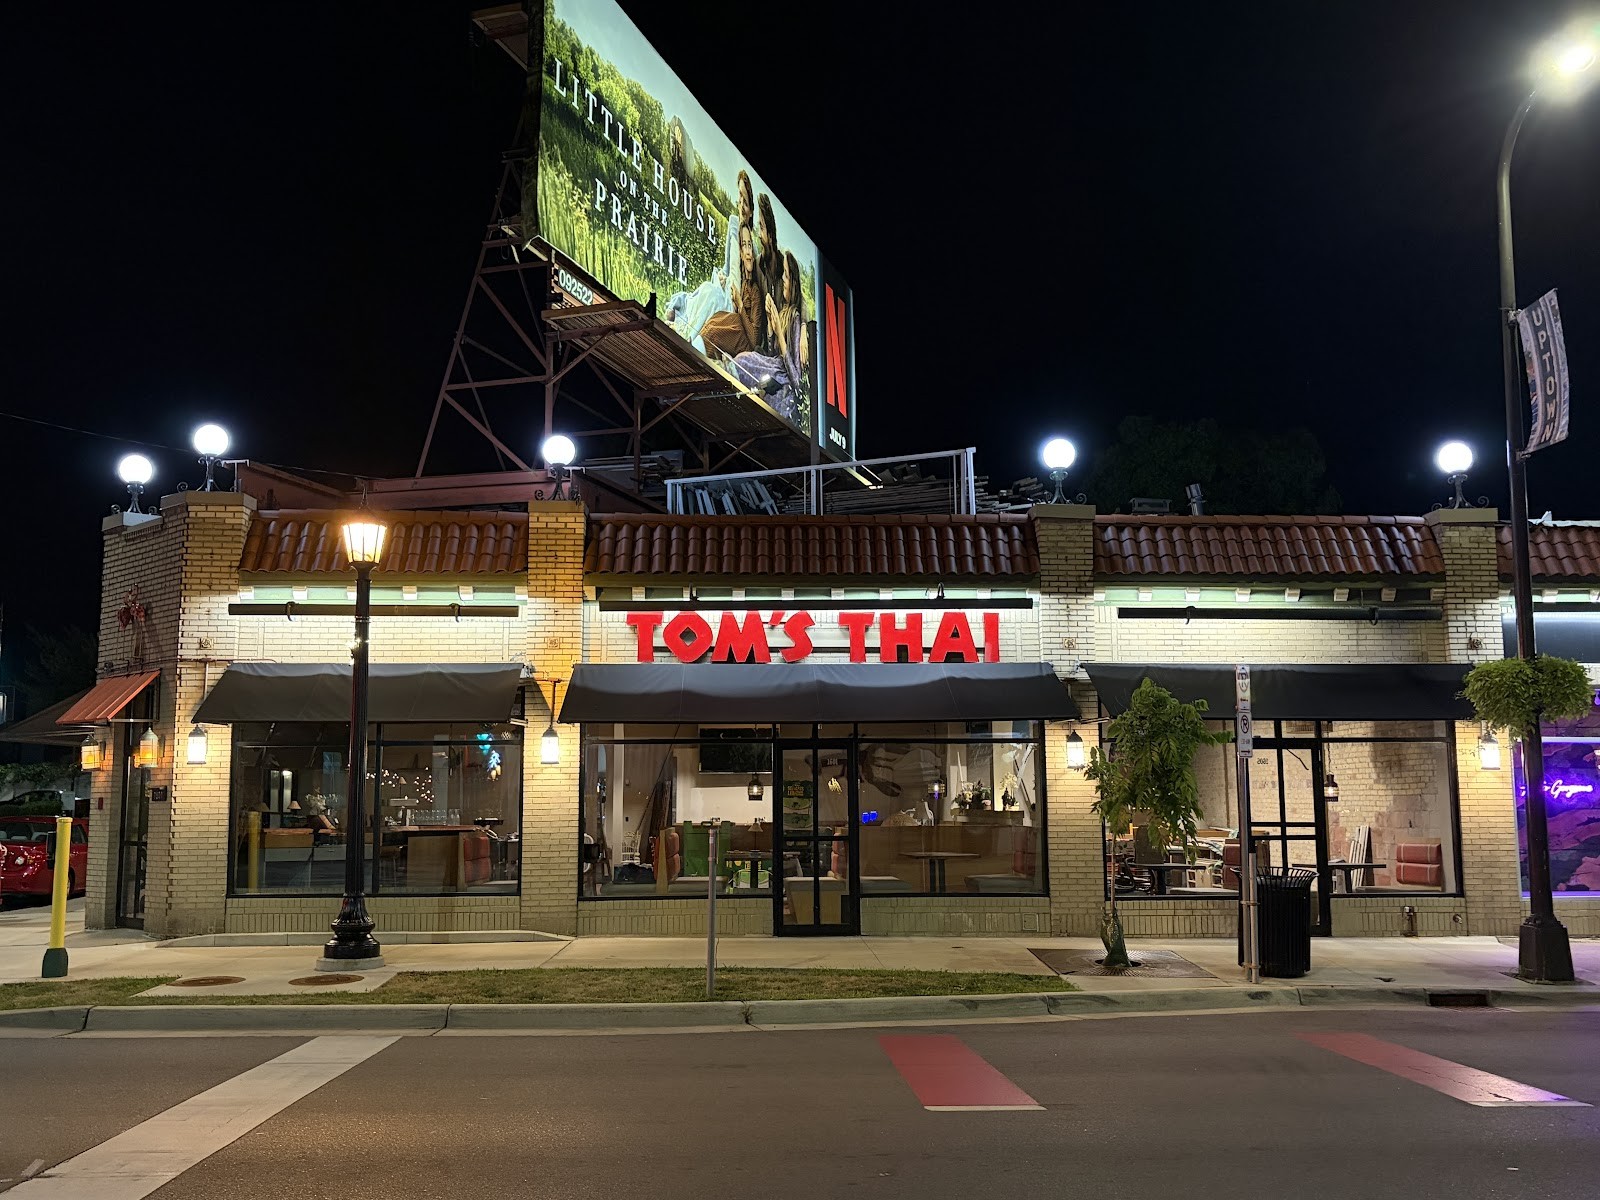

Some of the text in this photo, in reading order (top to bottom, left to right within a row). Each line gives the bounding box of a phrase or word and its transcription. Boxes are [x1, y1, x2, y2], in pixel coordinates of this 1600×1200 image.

[554, 57, 717, 246] LITTLE HOUSE
[594, 178, 688, 286] PRAIRIE
[620, 170, 668, 227] ON THE
[558, 269, 593, 306] 092522
[825, 282, 847, 417] N
[1532, 310, 1557, 442] UPTOWN
[829, 426, 847, 450] JULY 9
[625, 609, 1001, 664] TOM'S THAI
